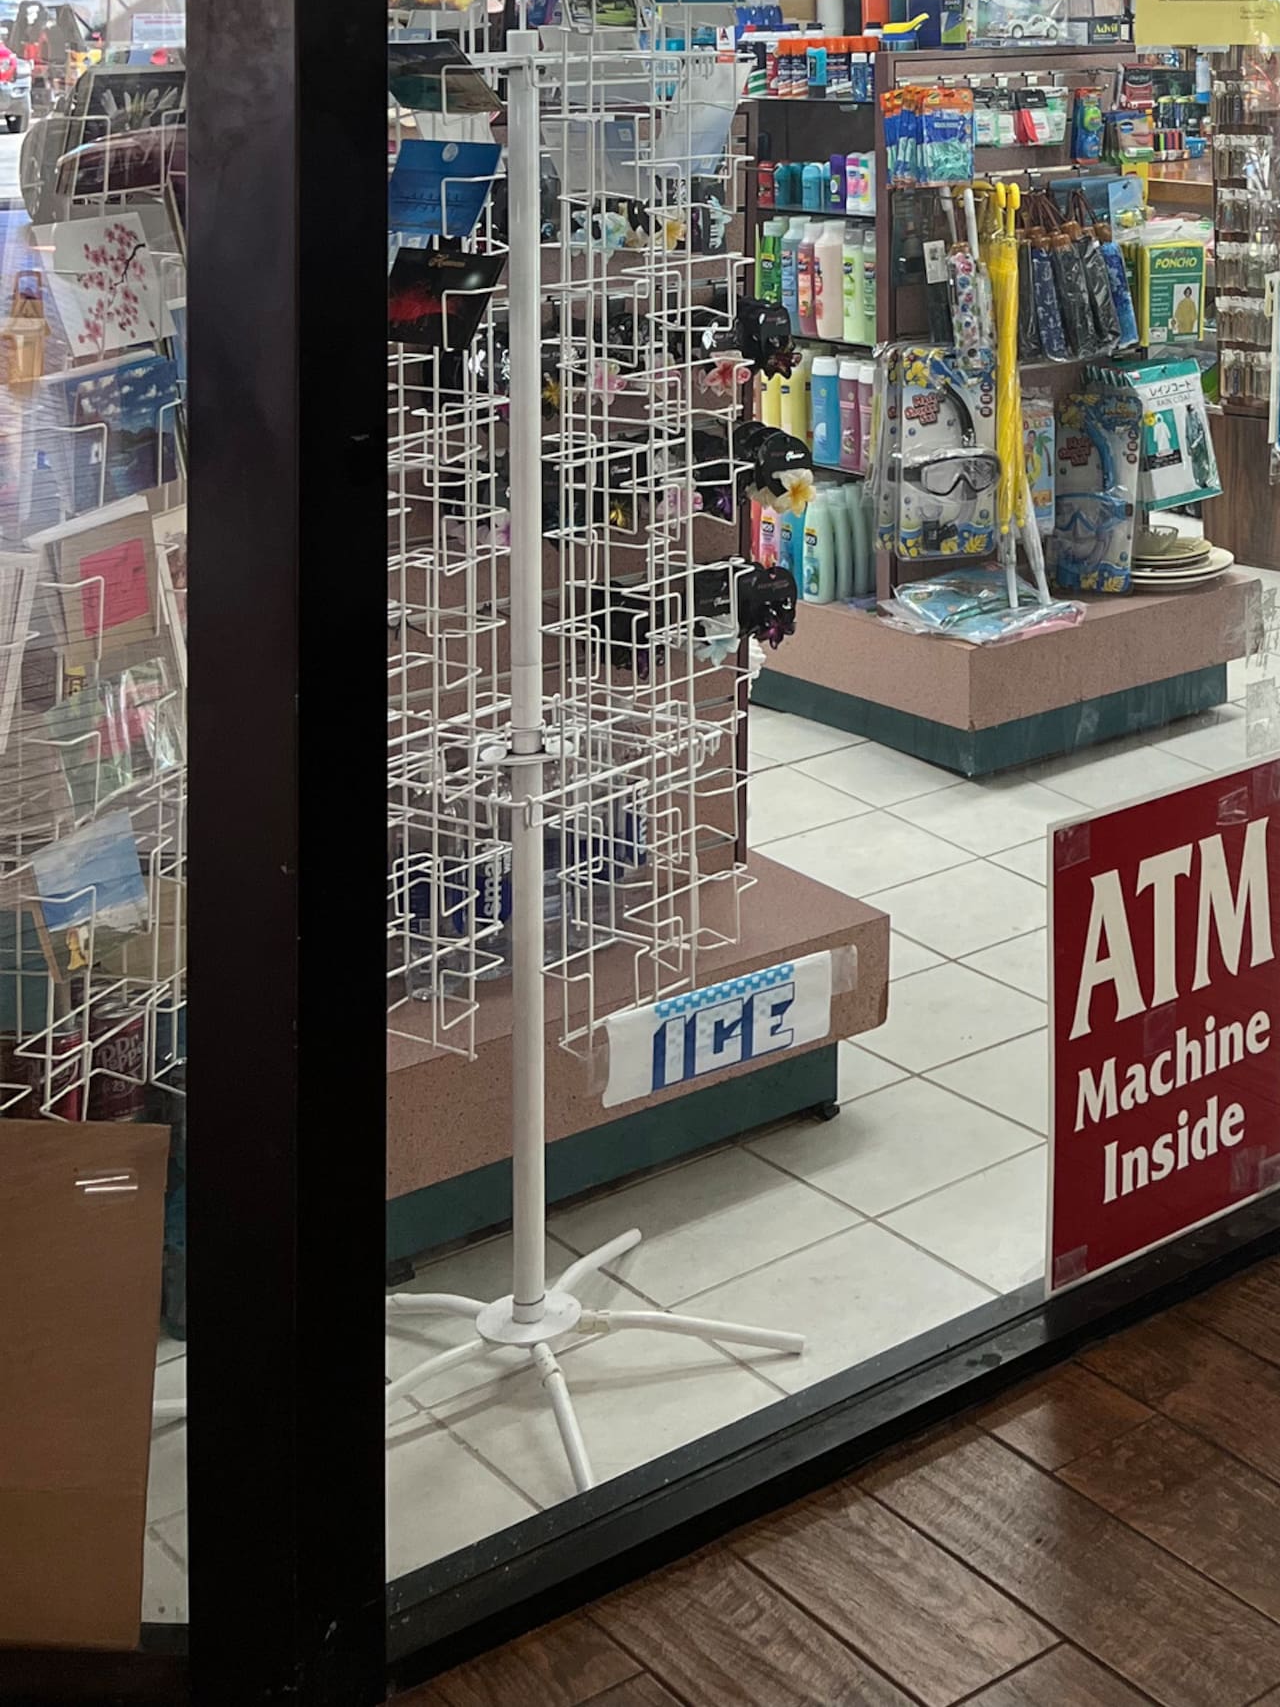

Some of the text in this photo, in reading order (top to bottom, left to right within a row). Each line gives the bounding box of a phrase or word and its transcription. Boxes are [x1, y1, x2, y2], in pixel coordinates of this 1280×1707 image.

[1155, 256, 1198, 269] PONCHO
[1149, 379, 1192, 397] レインコート
[1068, 816, 1275, 1041] ATM
[652, 981, 795, 1093] ICE
[1073, 1009, 1271, 1133] Machine
[1102, 1094, 1245, 1205] Inside
